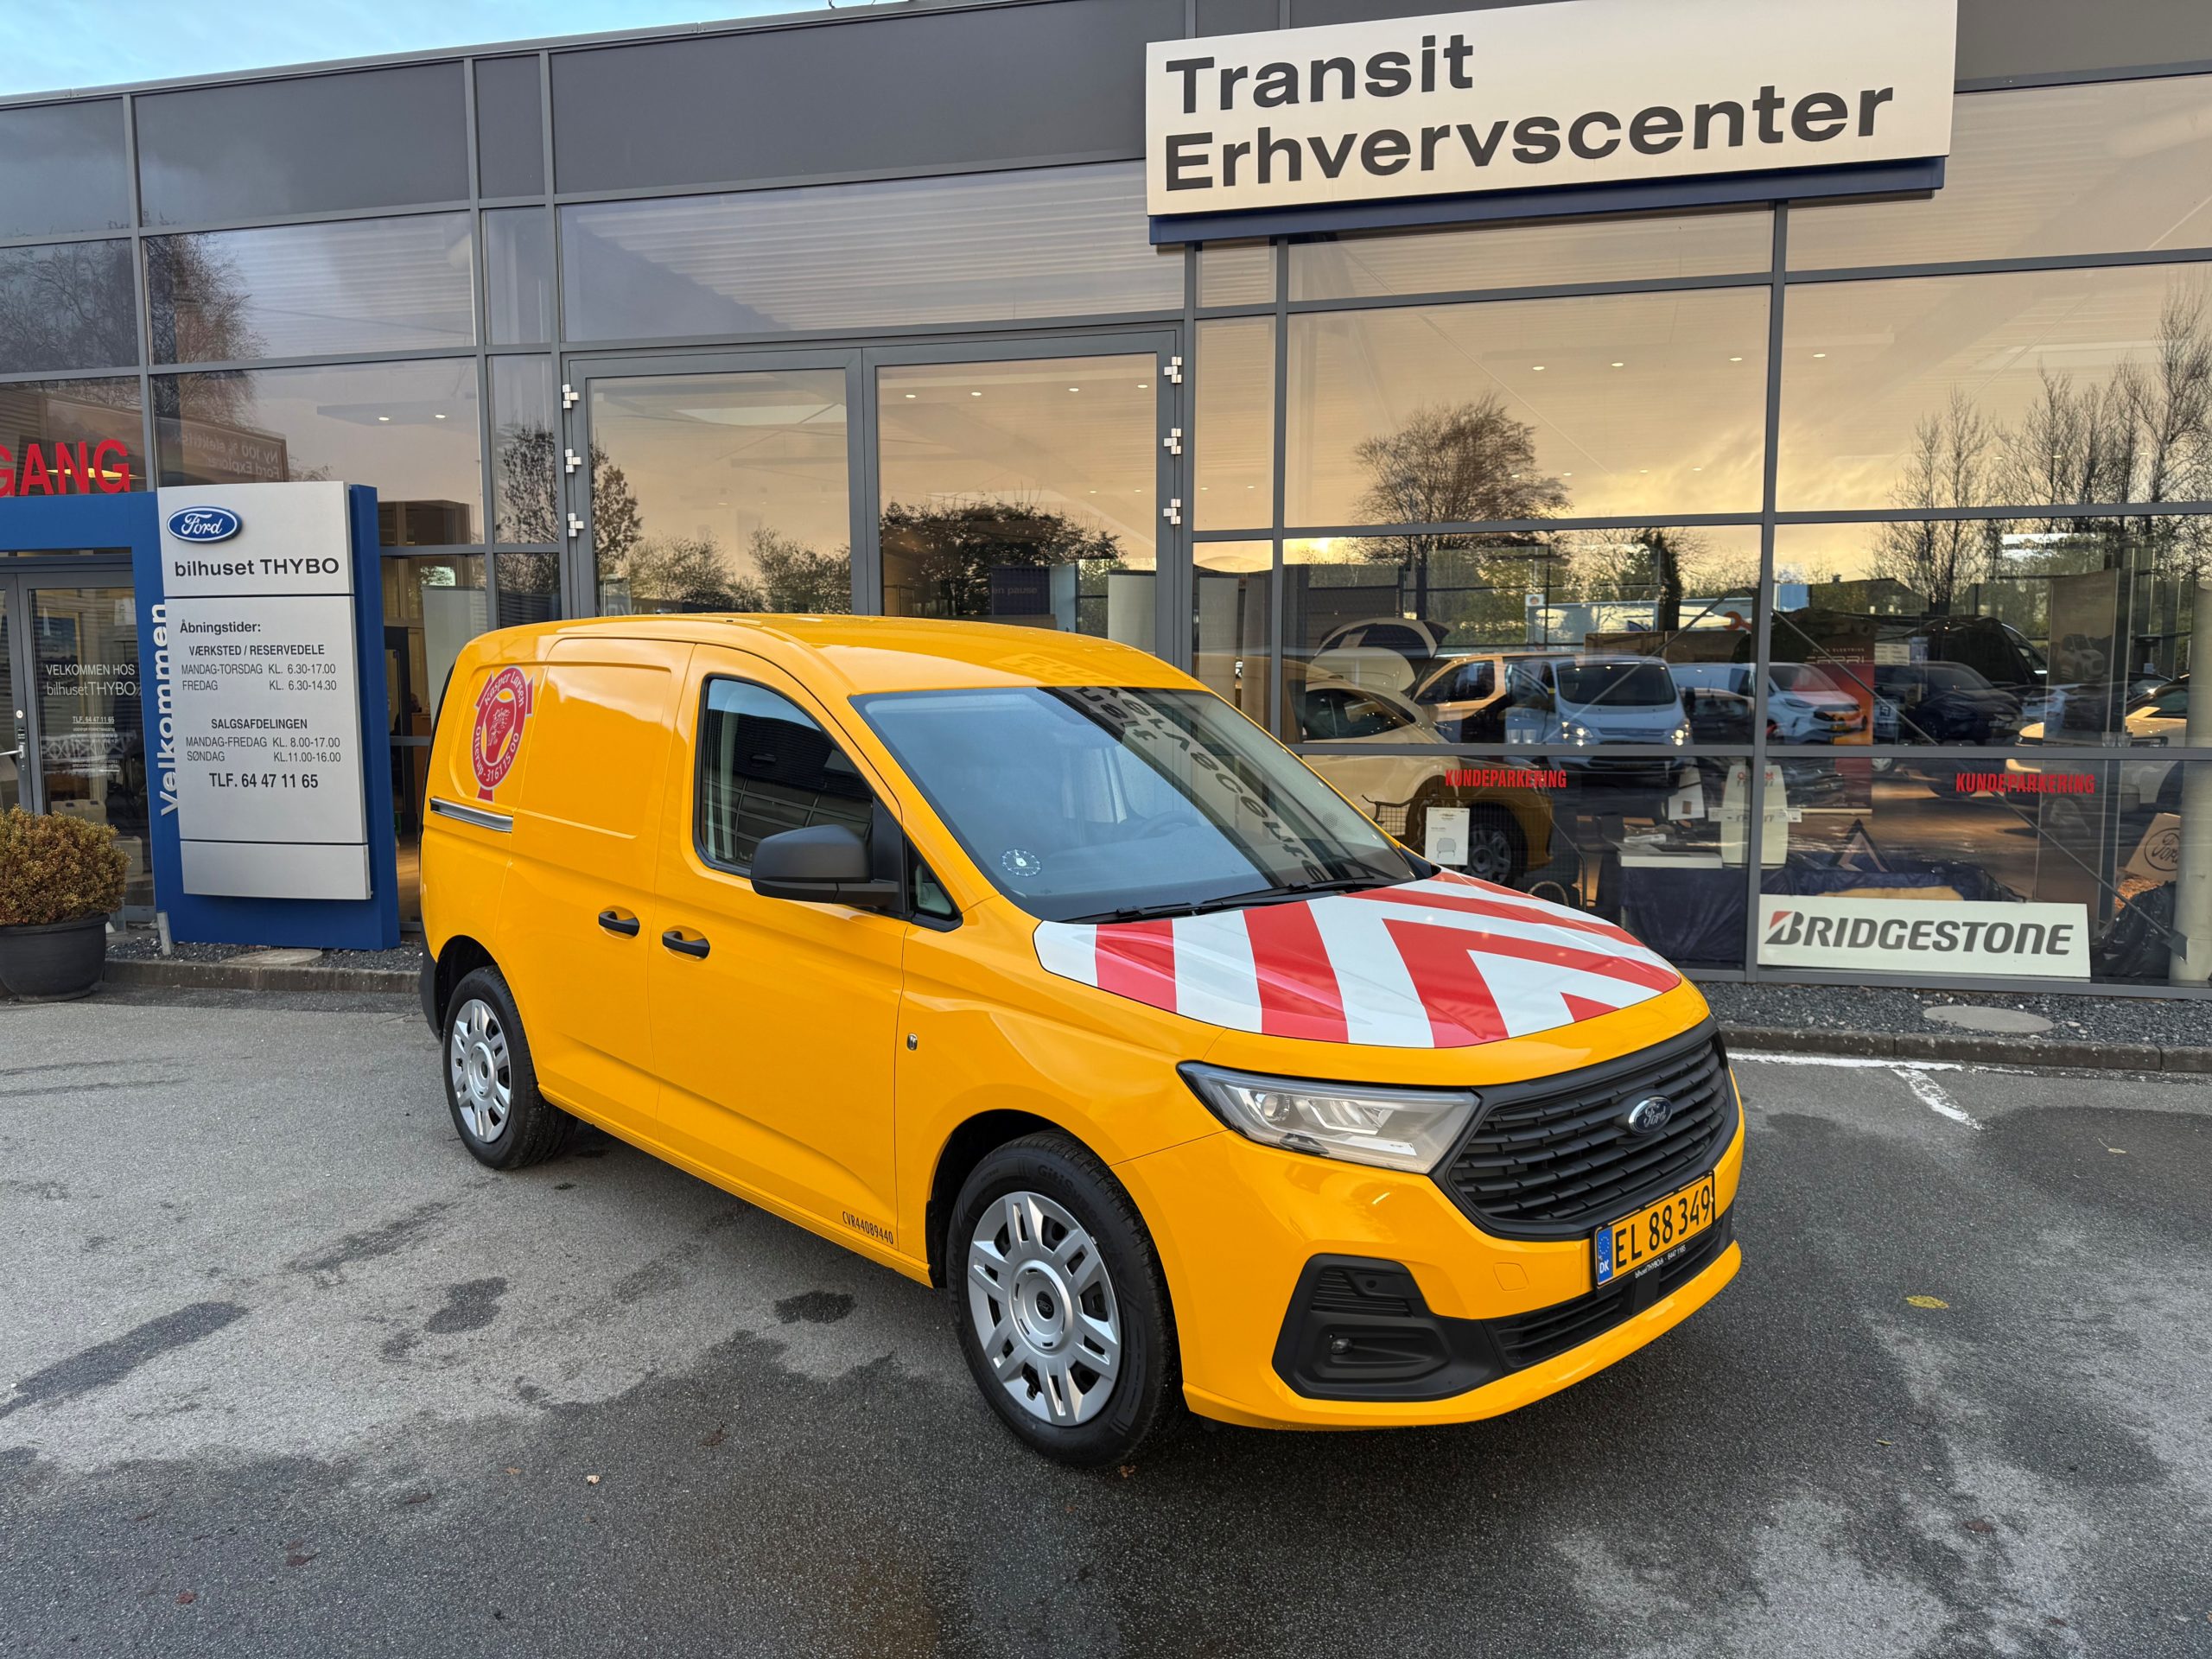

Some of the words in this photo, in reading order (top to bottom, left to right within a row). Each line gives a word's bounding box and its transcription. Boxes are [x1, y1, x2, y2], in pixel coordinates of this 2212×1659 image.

[1166, 34, 1474, 114] Transit
[1166, 86, 1893, 192] Erhvervscenter
[181, 512, 224, 535] Ford
[175, 560, 255, 576] bilhuset
[259, 557, 340, 575] THYBO
[180, 619, 261, 635] Åbningstider:
[189, 645, 242, 657] VÆRKSTED
[250, 645, 325, 656] RESERVEDELE
[46, 664, 111, 676] VELKOMMEN
[113, 664, 136, 676] HOS
[181, 664, 263, 675] MANDAG-TORSDAG
[268, 664, 283, 675] KL.
[287, 663, 336, 674] 6.30-17.00
[182, 680, 218, 691] FREDAG
[269, 680, 284, 691] KL.
[288, 680, 337, 690] 6.30-14.30
[511, 671, 524, 709] Larsen
[151, 604, 179, 817] Velkommen
[211, 719, 308, 729] SALGSAFDELINGEN
[186, 736, 267, 747] MANDAG-FREDAG
[272, 737, 288, 747] KL.
[290, 737, 340, 748] 8.00-17.00
[187, 751, 226, 762] SØNDAG
[209, 772, 238, 787] TLF.
[241, 773, 257, 788] 64
[261, 773, 276, 788] 47
[282, 773, 296, 788] 11
[302, 773, 319, 788] 65
[1445, 769, 1567, 788] KUNDEPARKERING
[1955, 772, 2095, 794] KUNDEPARKERING
[2152, 832, 2180, 863] For
[1764, 911, 2074, 956] BRIDGESTONE
[1643, 1103, 1667, 1128] Ford
[842, 1211, 893, 1244] CVR44089440
[1615, 1224, 1643, 1269] EL
[1649, 1205, 1673, 1251] 88
[1678, 1185, 1711, 1236] 349
[1599, 1260, 1610, 1274] DK
